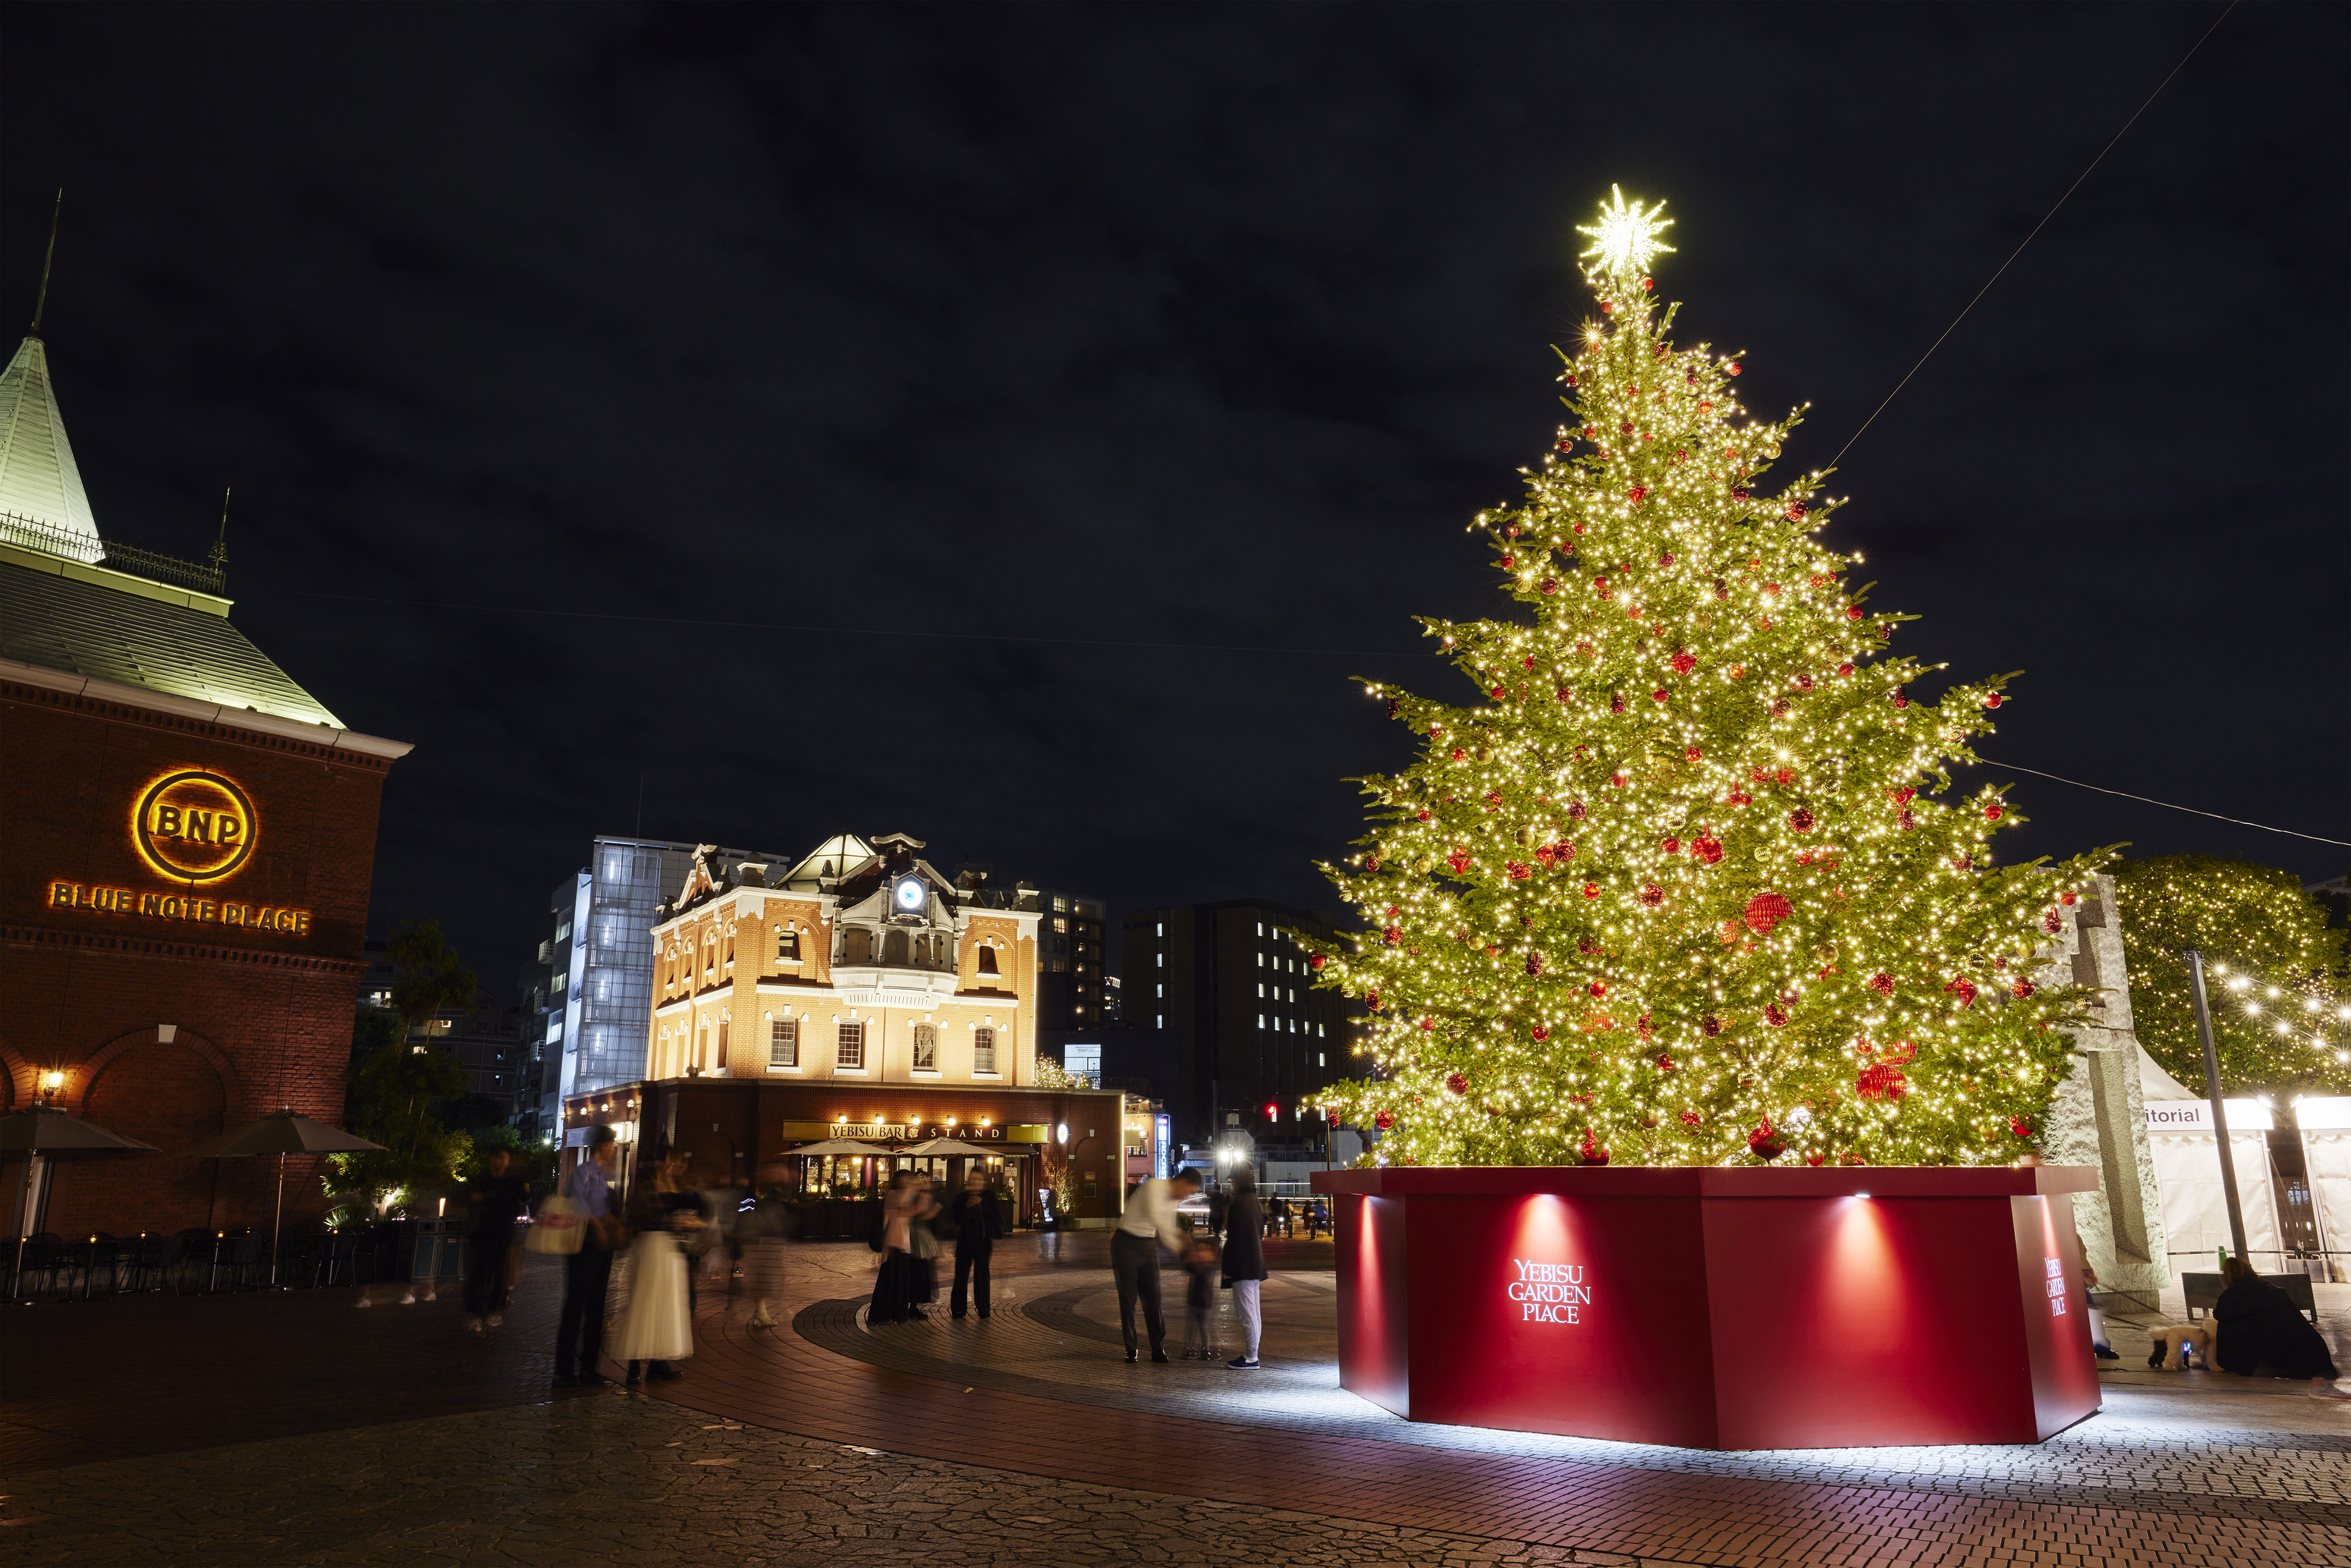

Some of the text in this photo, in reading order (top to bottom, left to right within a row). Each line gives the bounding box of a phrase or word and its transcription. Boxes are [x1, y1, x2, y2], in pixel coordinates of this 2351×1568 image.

[156, 806, 240, 843] BNP
[53, 883, 311, 934] BLUE NOTE PLACE
[832, 1126, 1000, 1138] YEBISU BAR STAND
[1513, 1258, 1583, 1284] YEBISU
[2044, 1256, 2061, 1278] YEBISU
[1507, 1282, 1592, 1305] GARDEN
[2046, 1277, 2066, 1298] GARDEN
[1522, 1302, 1579, 1324] PLACE
[2051, 1296, 2066, 1317] PLACE
